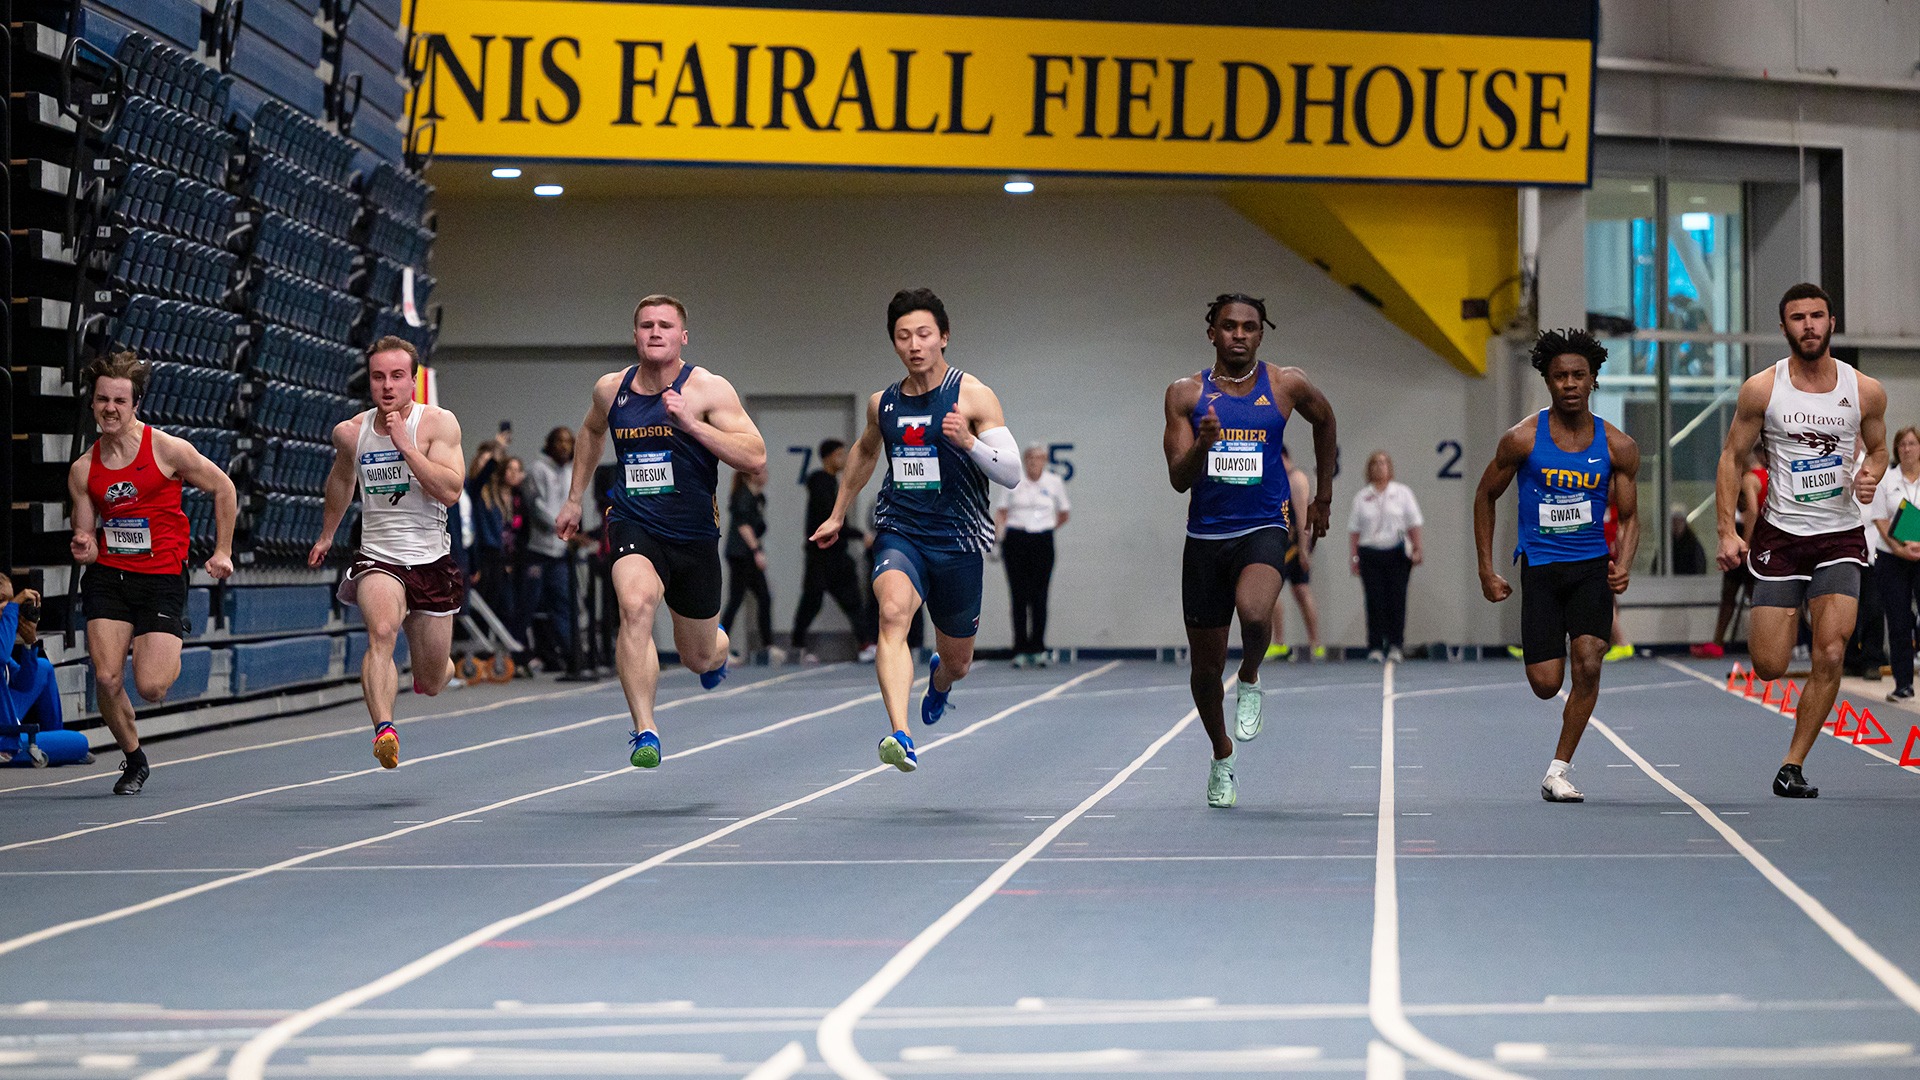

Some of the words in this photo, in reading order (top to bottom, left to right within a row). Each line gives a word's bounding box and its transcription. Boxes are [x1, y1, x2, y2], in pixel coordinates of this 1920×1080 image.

[413, 33, 581, 125] NIS
[610, 40, 995, 136] FAIRALL
[1023, 54, 1571, 152] FIELDHOUSE
[1783, 411, 1845, 426] uOttawa
[615, 425, 674, 439] WINDSOR
[1218, 428, 1267, 442] AURIER
[787, 446, 812, 485] 7
[1048, 443, 1073, 481] 5
[1215, 457, 1257, 472] QUAYSON
[1436, 441, 1462, 479] 2
[366, 466, 402, 481] GURNSEY
[630, 467, 668, 482] VERESUK
[903, 462, 925, 476] TANG
[1541, 468, 1601, 489] TMU
[1801, 471, 1836, 489] NELSON
[1550, 508, 1581, 522] GWATA
[112, 531, 144, 544] TESSIER
